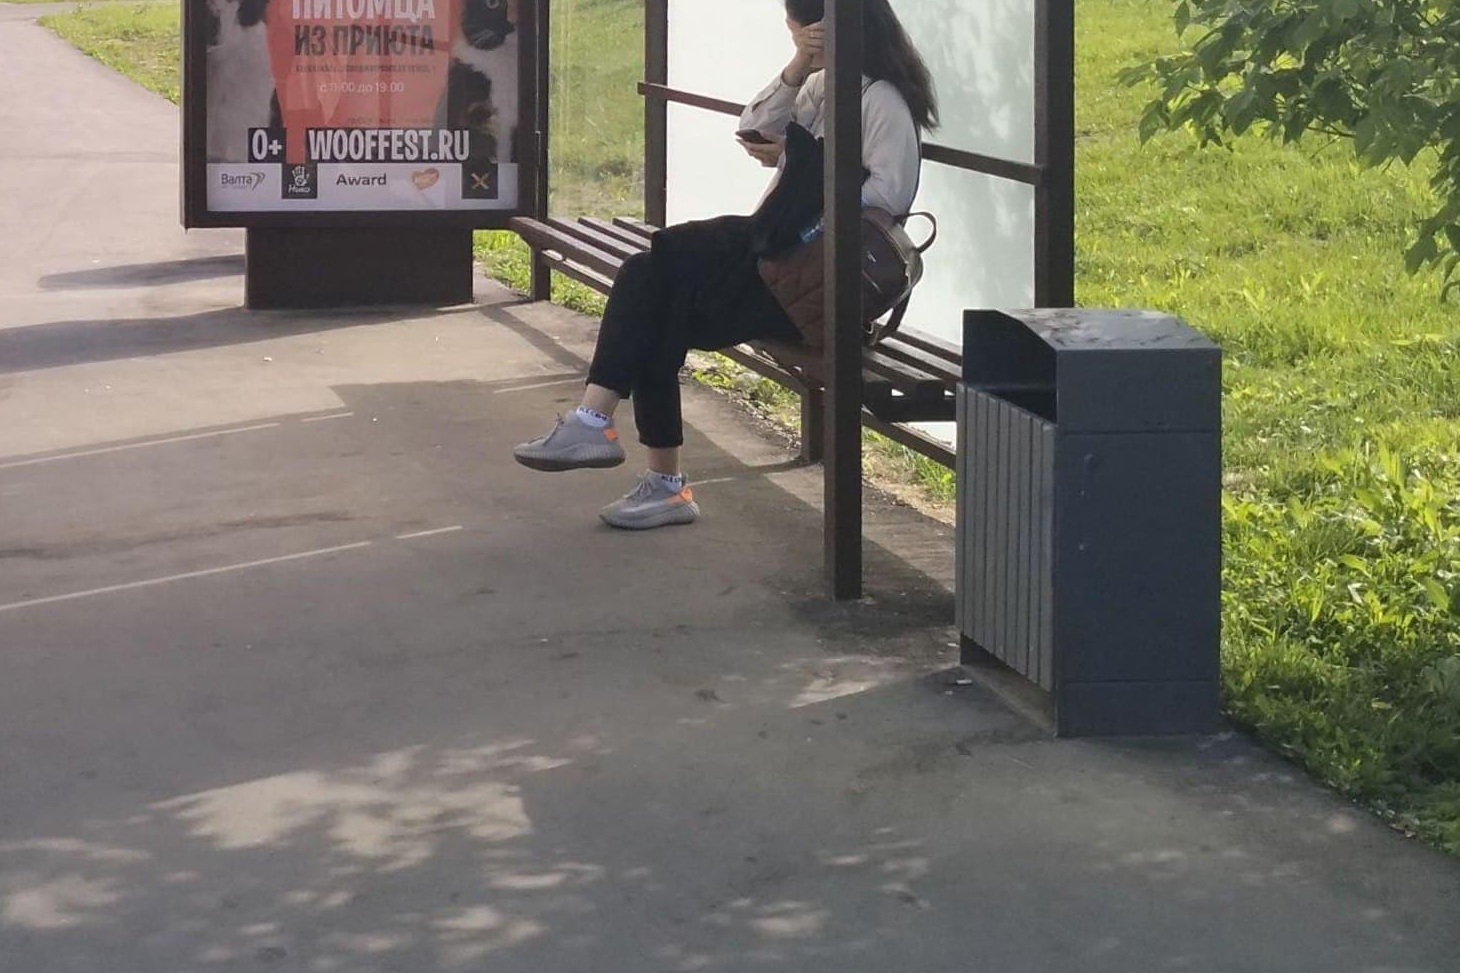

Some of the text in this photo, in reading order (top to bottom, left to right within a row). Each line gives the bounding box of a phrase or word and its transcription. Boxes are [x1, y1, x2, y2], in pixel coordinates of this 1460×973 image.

[294, 25, 435, 56] ИЗ ПРИЮТА
[252, 129, 283, 160] 0+
[308, 129, 470, 161] WOOFFEST.RU
[336, 174, 387, 186] Award
